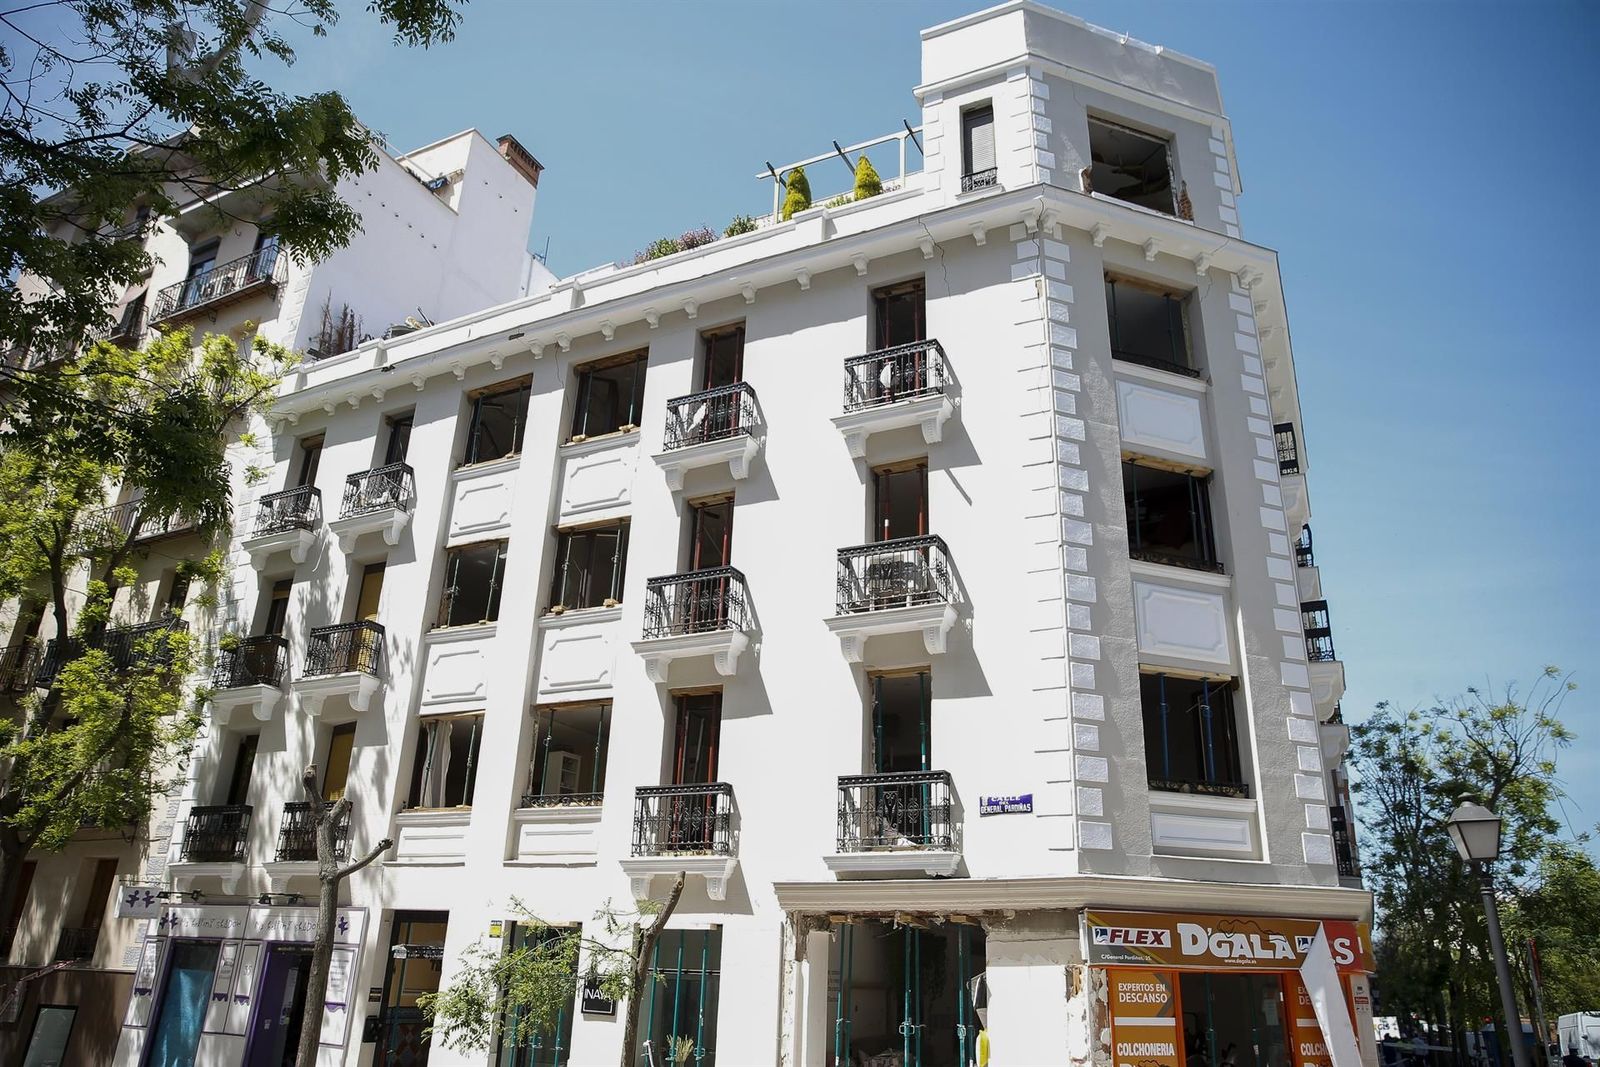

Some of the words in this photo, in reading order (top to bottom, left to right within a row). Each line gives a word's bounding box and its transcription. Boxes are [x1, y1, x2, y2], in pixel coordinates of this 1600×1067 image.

[1109, 928, 1167, 946] FLEX
[1118, 983, 1154, 993] EXPERTOS
[1156, 983, 1166, 992] EN
[1118, 991, 1168, 1004] DESCANSO
[1117, 1042, 1175, 1057] COLCHONERIA
